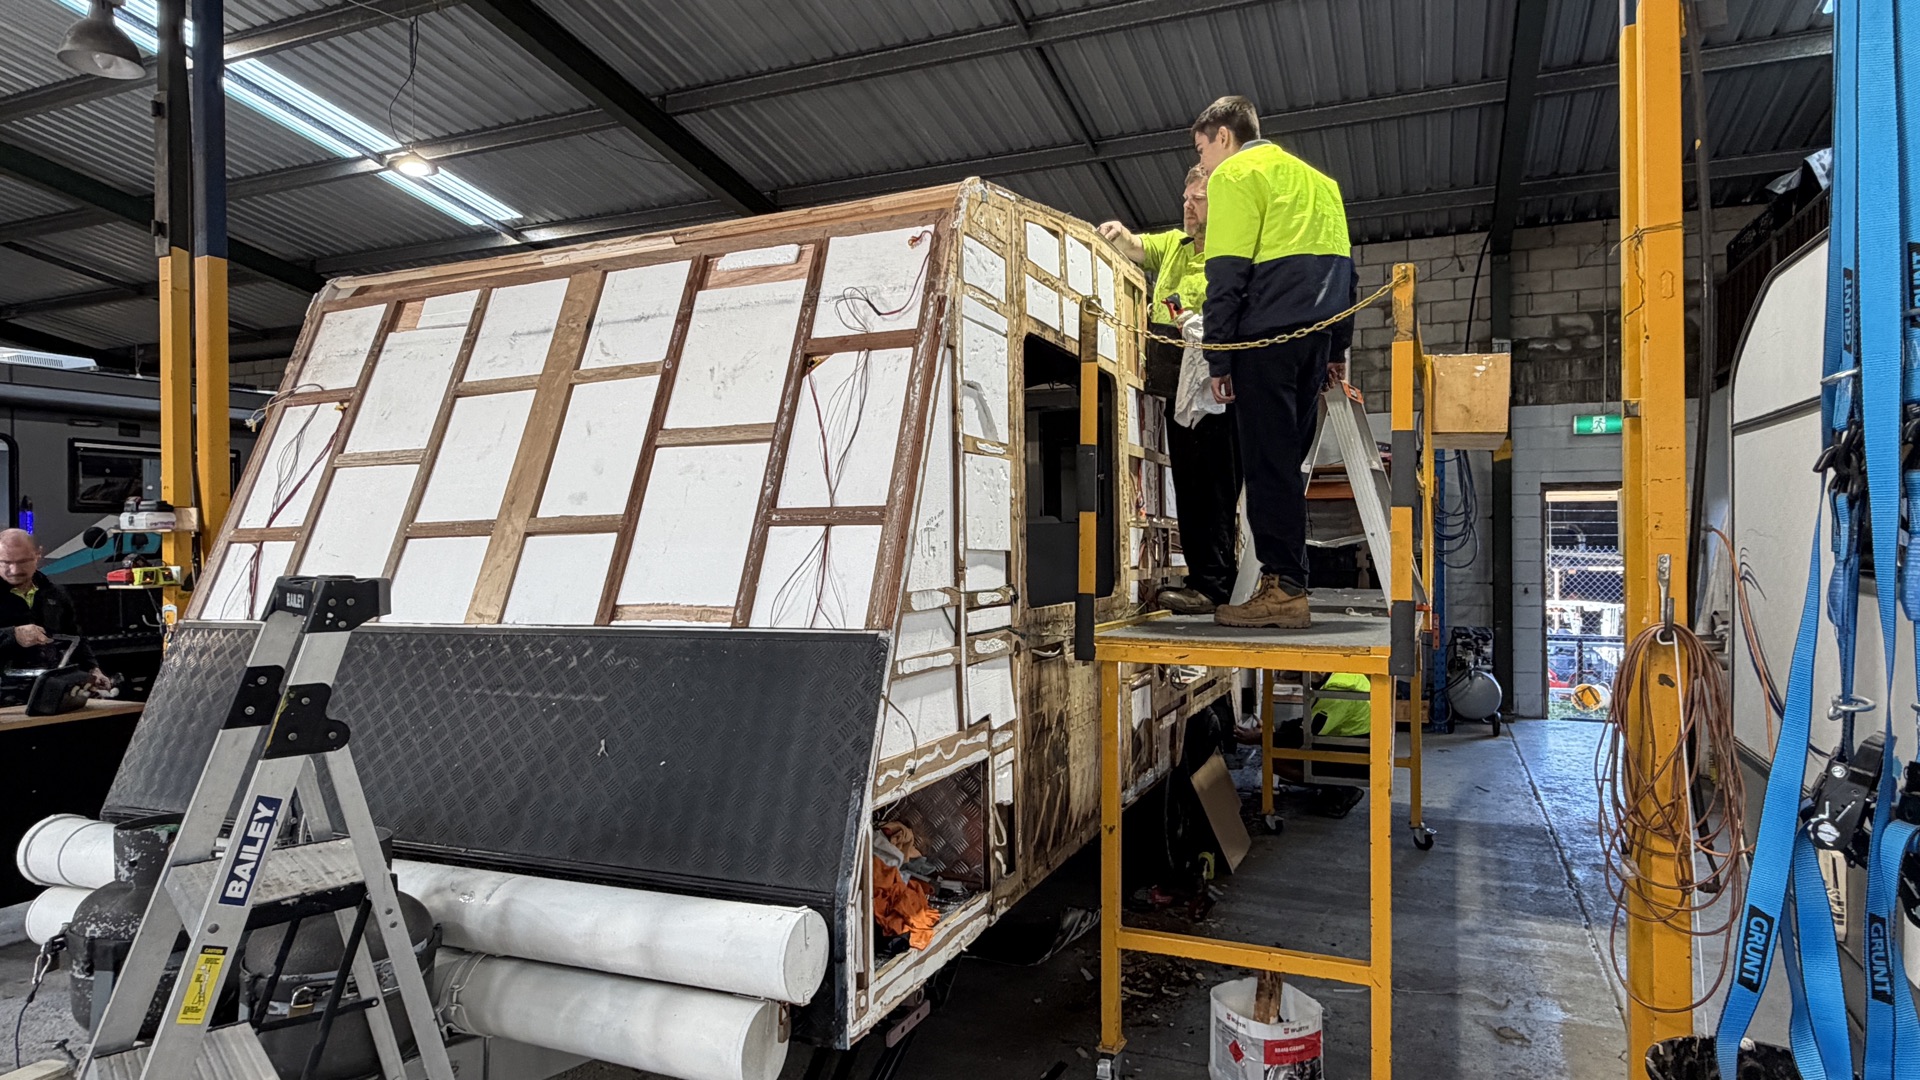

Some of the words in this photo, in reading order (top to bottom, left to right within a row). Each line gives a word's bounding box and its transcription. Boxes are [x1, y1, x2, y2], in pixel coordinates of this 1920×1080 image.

[1844, 277, 1852, 345] GRUNT
[286, 592, 305, 609] BAILEY
[225, 802, 275, 899] BAILEY
[1741, 916, 1769, 984] GRUNT
[1871, 922, 1892, 996] GRUNT
